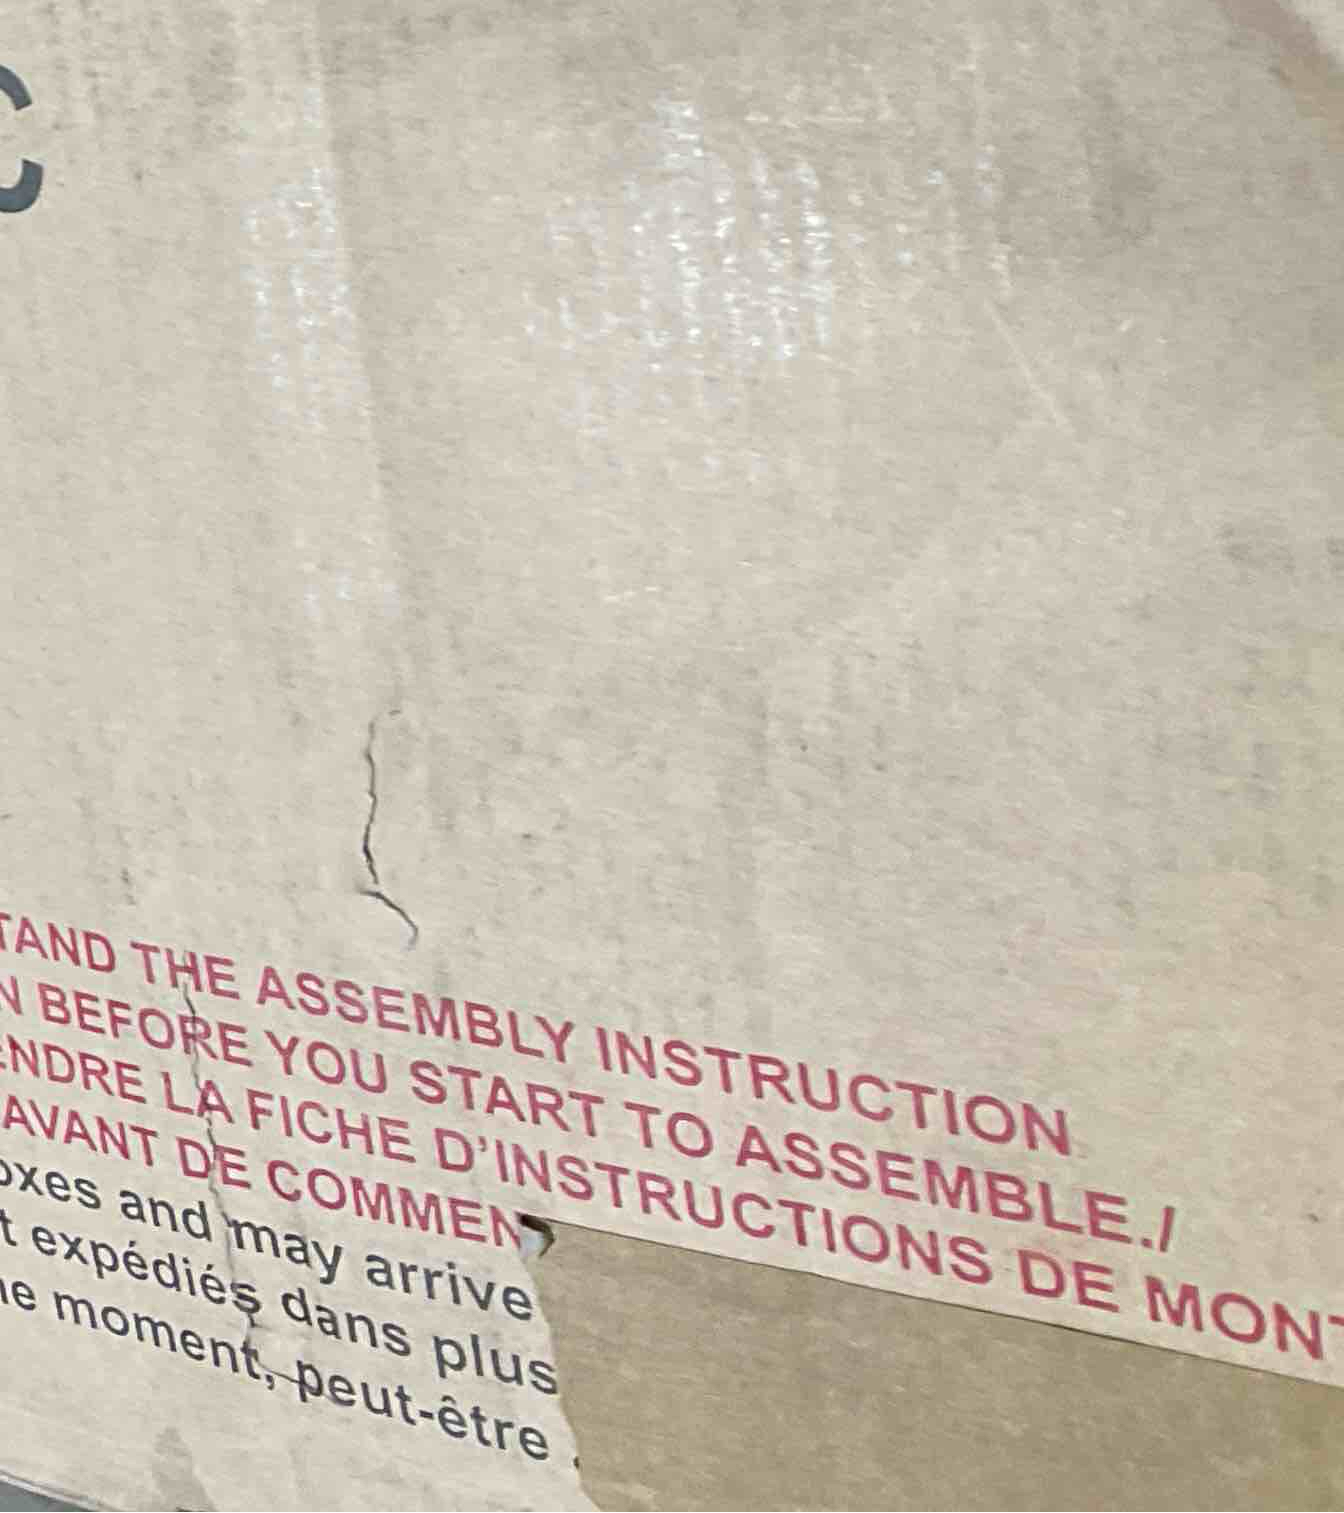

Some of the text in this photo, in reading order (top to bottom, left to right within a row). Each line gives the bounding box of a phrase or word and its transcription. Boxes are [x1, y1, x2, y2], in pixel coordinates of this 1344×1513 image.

[37, 983, 254, 1067] BEFORE
[265, 1031, 387, 1094] YOU
[411, 1060, 605, 1137] START
[624, 1100, 714, 1158] TO
[130, 941, 240, 1000] THE
[256, 966, 575, 1064] ASSEMBLY
[596, 1026, 1071, 1156] INSTRUCTION
[3, 1095, 159, 1167] AVANT
[176, 1136, 251, 1190] DE
[161, 1072, 234, 1124] LA
[247, 1088, 416, 1163] FICHE
[435, 1127, 992, 1285] D'INSTRUCTIONS
[1018, 1250, 1120, 1312] DE
[1145, 1276, 1344, 1361] MON
[32, 1225, 261, 1314] expédiés
[282, 1288, 411, 1357] dans
[434, 1334, 557, 1395] plus
[120, 1189, 213, 1242] and
[229, 1217, 343, 1284] may
[366, 1251, 533, 1321] arrive
[54, 1291, 275, 1390] moment,
[297, 1359, 548, 1460] peut-être
